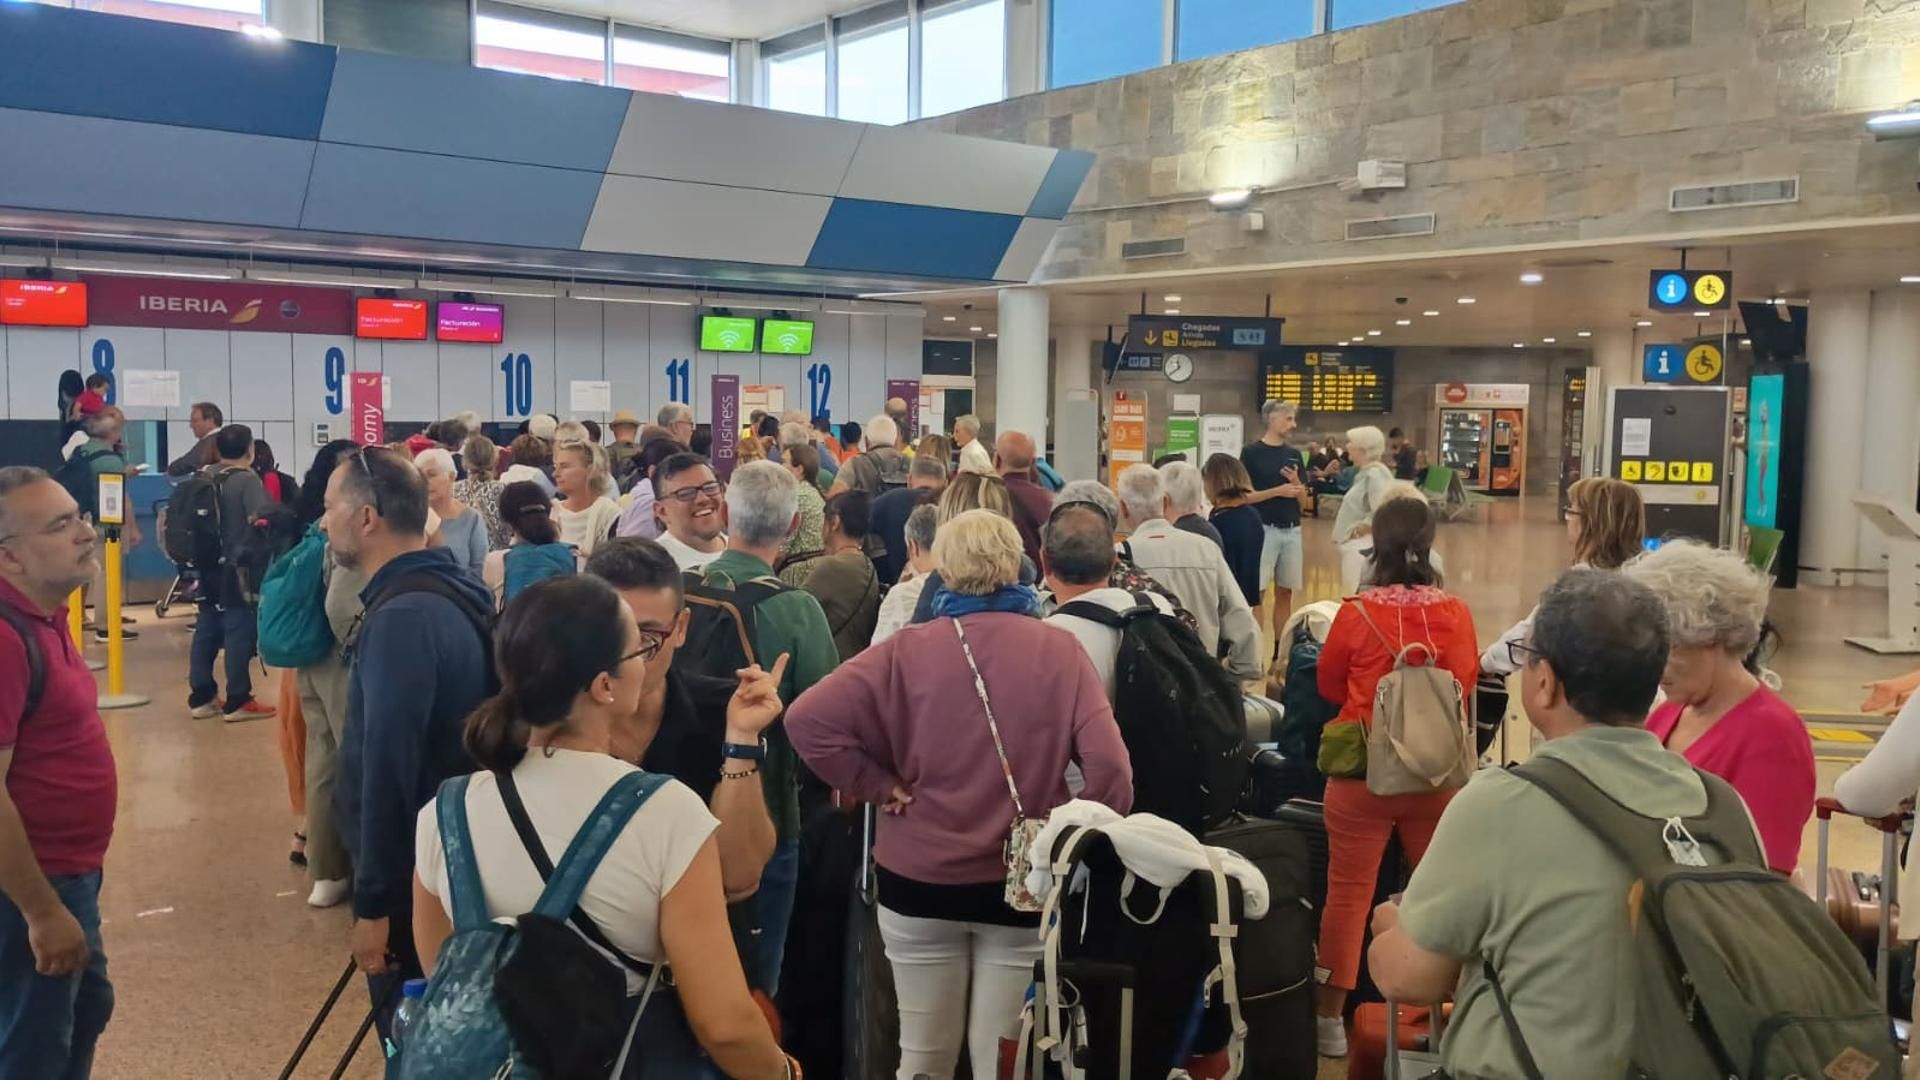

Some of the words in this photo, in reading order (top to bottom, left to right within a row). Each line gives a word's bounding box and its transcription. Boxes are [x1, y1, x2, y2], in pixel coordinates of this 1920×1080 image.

[140, 295, 228, 313] IBERIA
[1182, 323, 1220, 332] Chegadas
[1182, 339, 1216, 347] Llegadas
[92, 338, 116, 406] 8
[325, 346, 345, 415] 9
[500, 352, 532, 416] 10
[666, 358, 690, 405] 11
[807, 363, 832, 419] 12
[718, 394, 733, 459] Business
